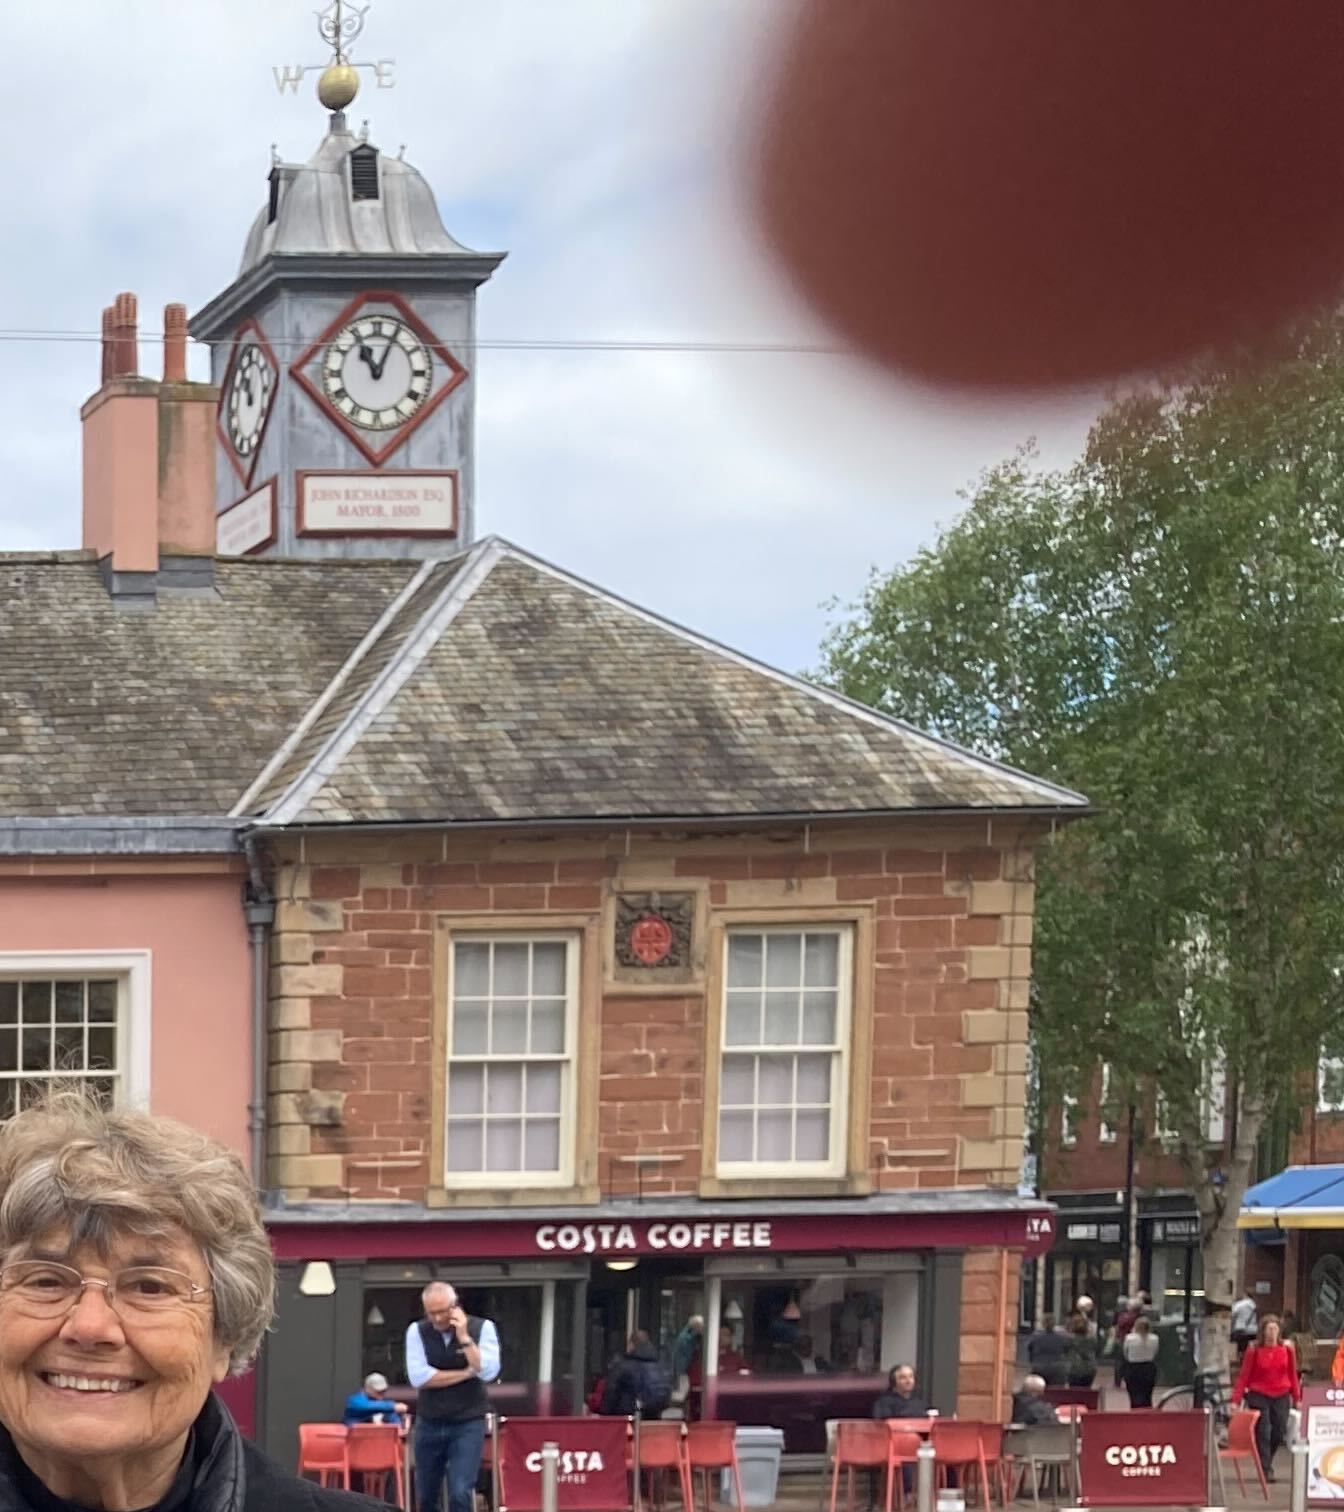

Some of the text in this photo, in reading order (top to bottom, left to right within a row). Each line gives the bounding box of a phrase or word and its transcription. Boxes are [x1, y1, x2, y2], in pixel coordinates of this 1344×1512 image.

[536, 1222, 772, 1253] COSTA COFFEE
[525, 1451, 604, 1474] CSTA
[1105, 1444, 1177, 1466] COSTA
[1122, 1466, 1161, 1477] COFFEE
